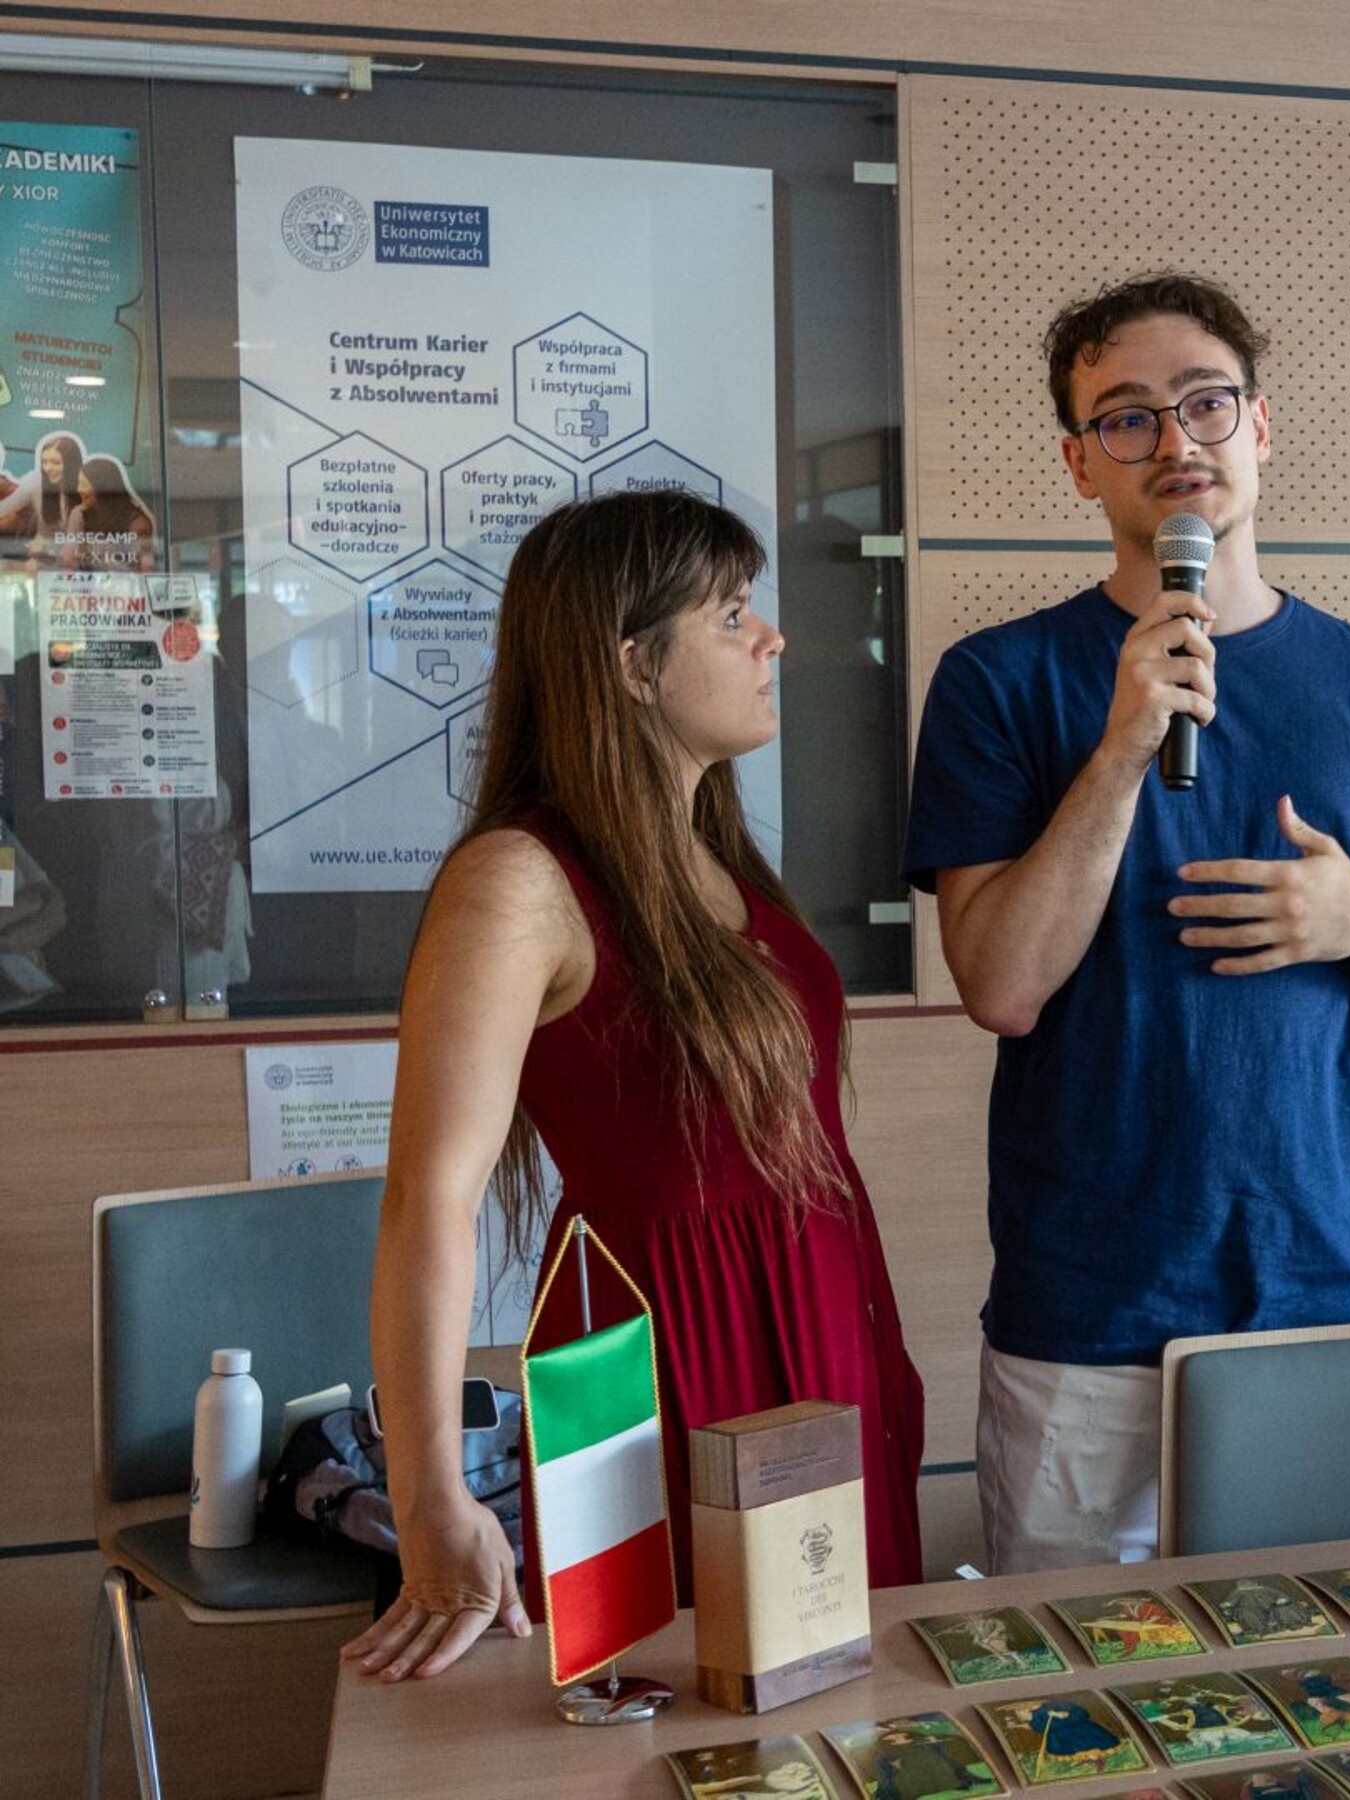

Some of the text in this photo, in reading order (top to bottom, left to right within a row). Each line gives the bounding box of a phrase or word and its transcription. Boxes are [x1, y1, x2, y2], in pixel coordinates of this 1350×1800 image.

[0, 149, 115, 173] ADEMIKI
[12, 185, 59, 200] XIOR
[380, 206, 481, 226] Uniwersytet
[381, 225, 482, 245] Ekonomiczny
[382, 244, 483, 261] w Katowicach
[329, 331, 489, 353] Centrum Karier
[538, 340, 623, 357] Współpraca
[330, 356, 466, 382] i Współpracy
[546, 360, 616, 375] z firmami
[330, 384, 499, 405] z Absolwentami
[531, 378, 631, 398] i instytucjami
[320, 459, 396, 475] Bezpłatne
[323, 479, 394, 494] szkolenia
[461, 470, 556, 489] Oferty pracy,
[316, 498, 401, 515] i spotkania
[481, 492, 538, 507] praktyk
[469, 510, 474, 523] i
[54, 532, 138, 545] BASECAMP
[405, 587, 472, 603] Wywiady
[51, 596, 146, 612] ZATRUDNI
[51, 615, 152, 628] PRACOWNIKA!
[381, 607, 496, 621] z Absolwentami
[390, 626, 488, 642] (ścieżki karier)
